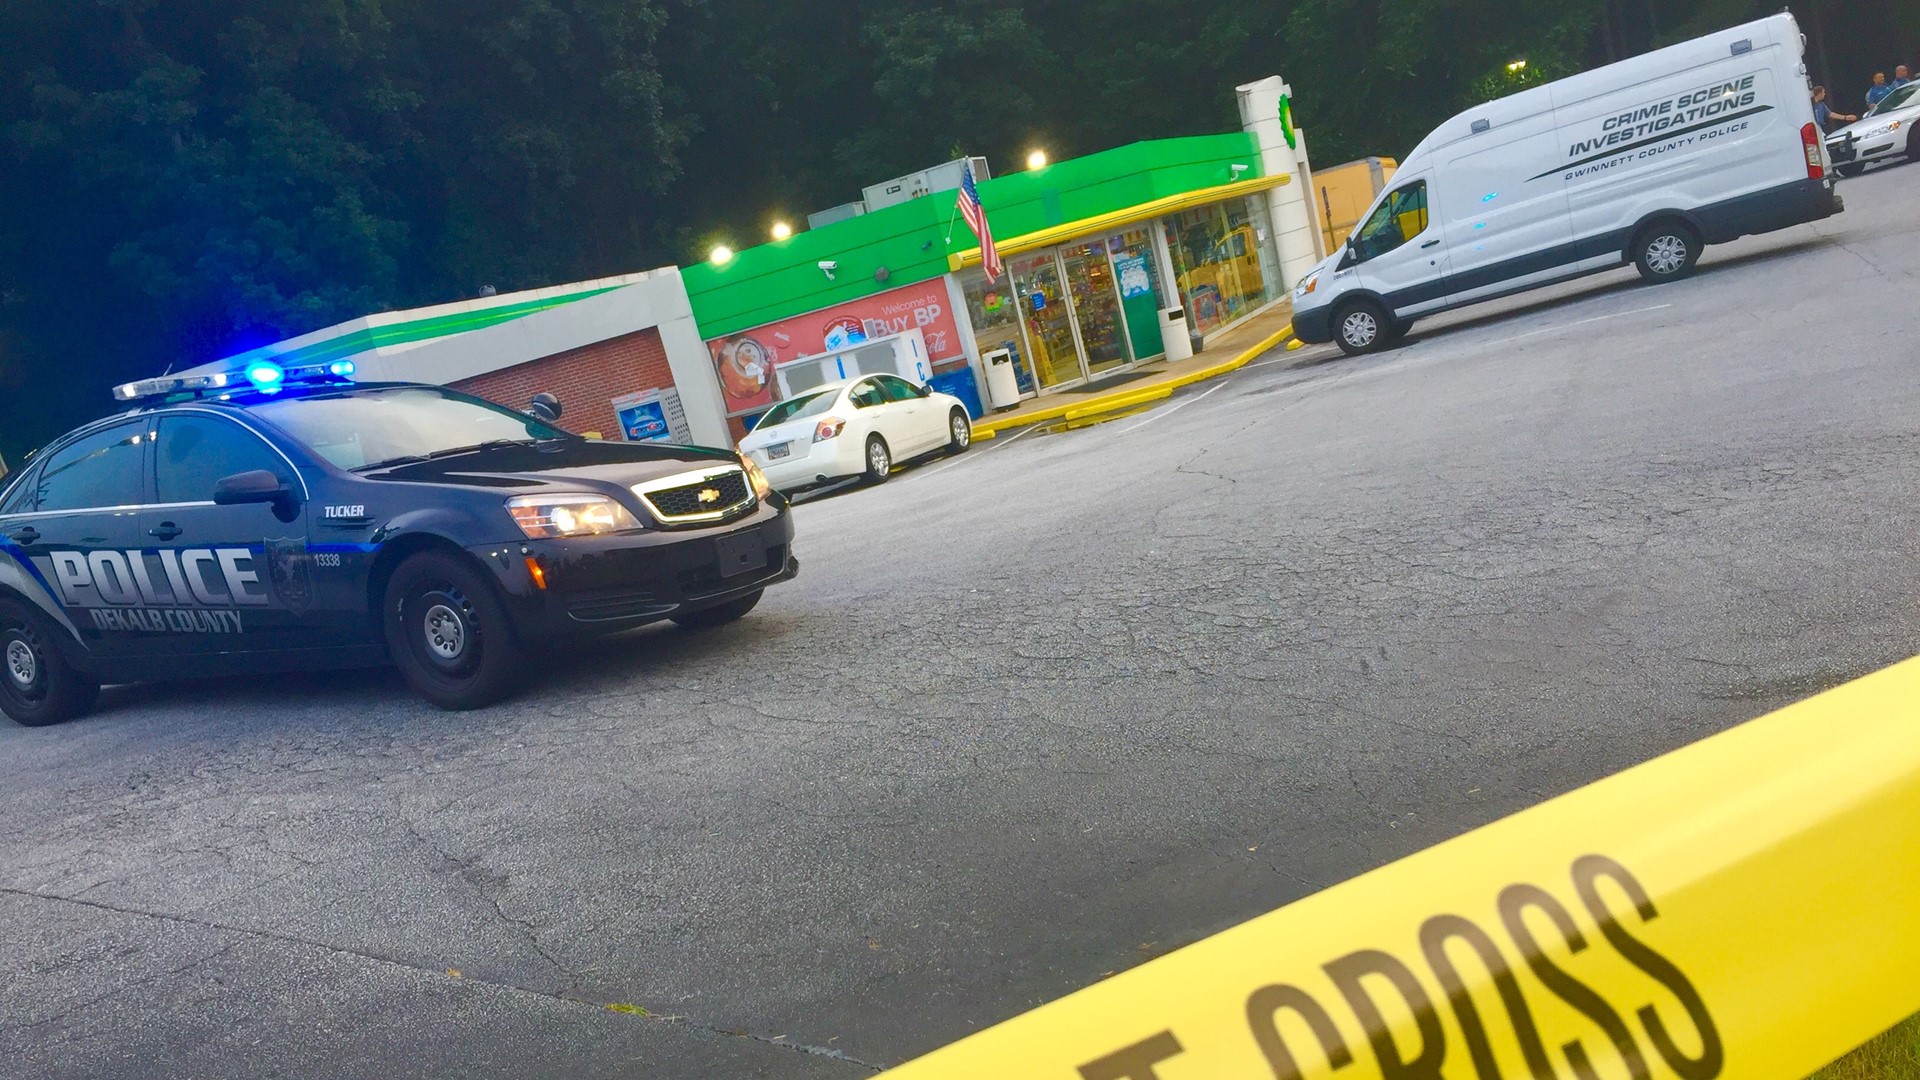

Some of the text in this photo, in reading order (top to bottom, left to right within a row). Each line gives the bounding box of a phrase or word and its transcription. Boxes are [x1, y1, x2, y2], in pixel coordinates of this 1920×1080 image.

[1602, 75, 1755, 131] CRIME SCENE
[1568, 91, 1755, 157] INVESTIGATIONS
[1565, 121, 1749, 181] GWINNETT COUNTY POLICE
[874, 315, 908, 338] BUY
[914, 304, 941, 327] BP
[881, 294, 937, 316] Welcome to
[324, 505, 365, 518] TUCKER
[49, 548, 268, 606] POLICE
[314, 553, 341, 567] 13338
[89, 608, 243, 633] DEKALB COUNTY
